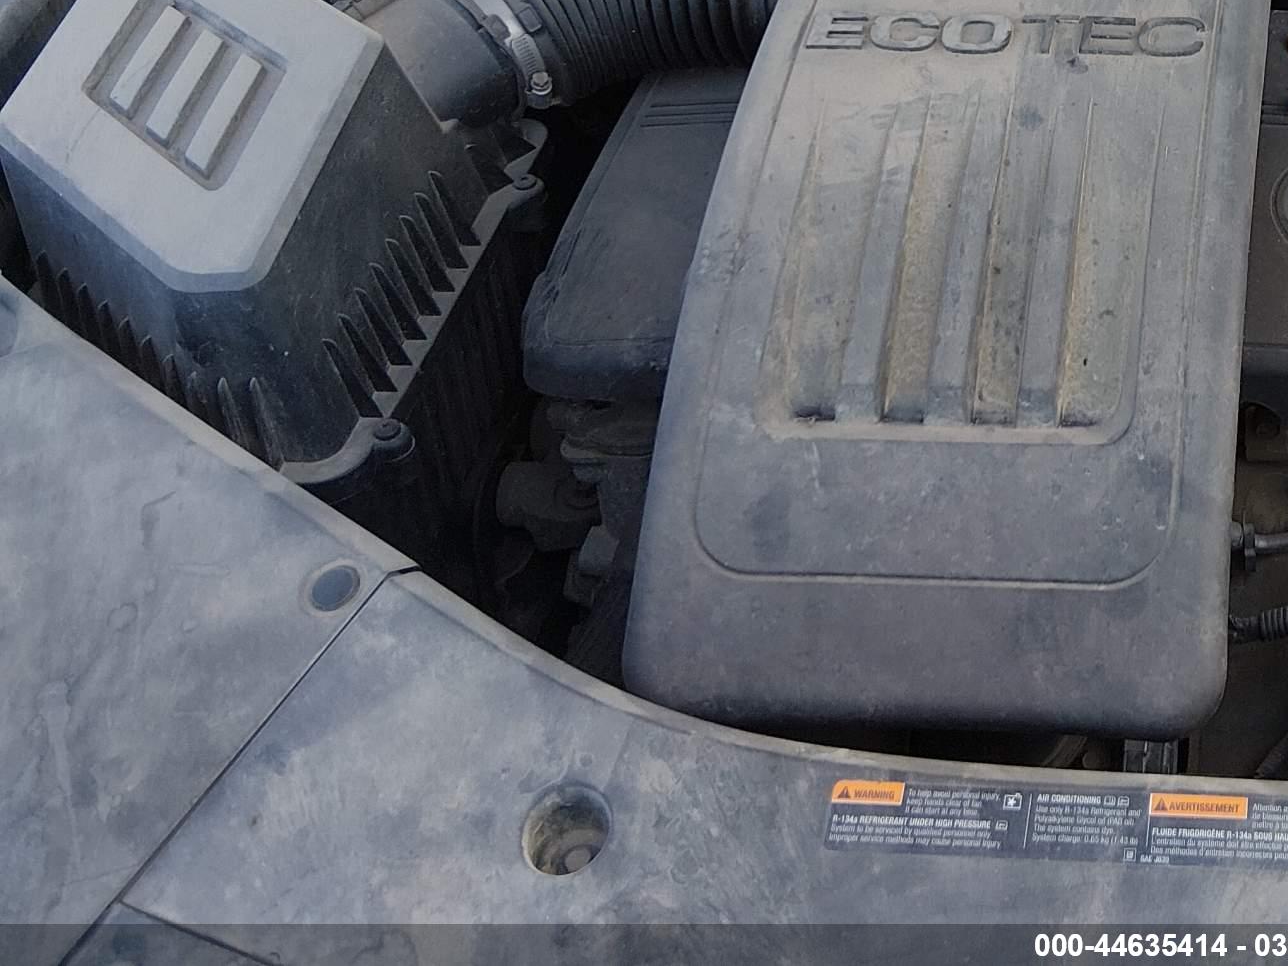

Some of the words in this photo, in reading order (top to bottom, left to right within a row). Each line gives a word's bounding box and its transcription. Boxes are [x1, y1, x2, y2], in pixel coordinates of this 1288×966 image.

[805, 10, 1208, 58] ECOTEC
[854, 789, 895, 800] WARNING
[951, 791, 981, 800] personal
[1036, 793, 1050, 803] AIR
[1051, 794, 1101, 804] CONDITIONING
[1169, 801, 1240, 813] AVERTISSEMENT
[832, 814, 858, 824] R-134a
[859, 815, 909, 826] REFRIGERANT
[909, 817, 934, 827] UNDER
[935, 818, 953, 827] HIGH
[953, 819, 991, 829] PRESSURE
[829, 833, 858, 843] Improper
[1151, 827, 1177, 837] FLUIDE
[1226, 830, 1252, 840] R-134a
[1253, 831, 1273, 841] SOUS
